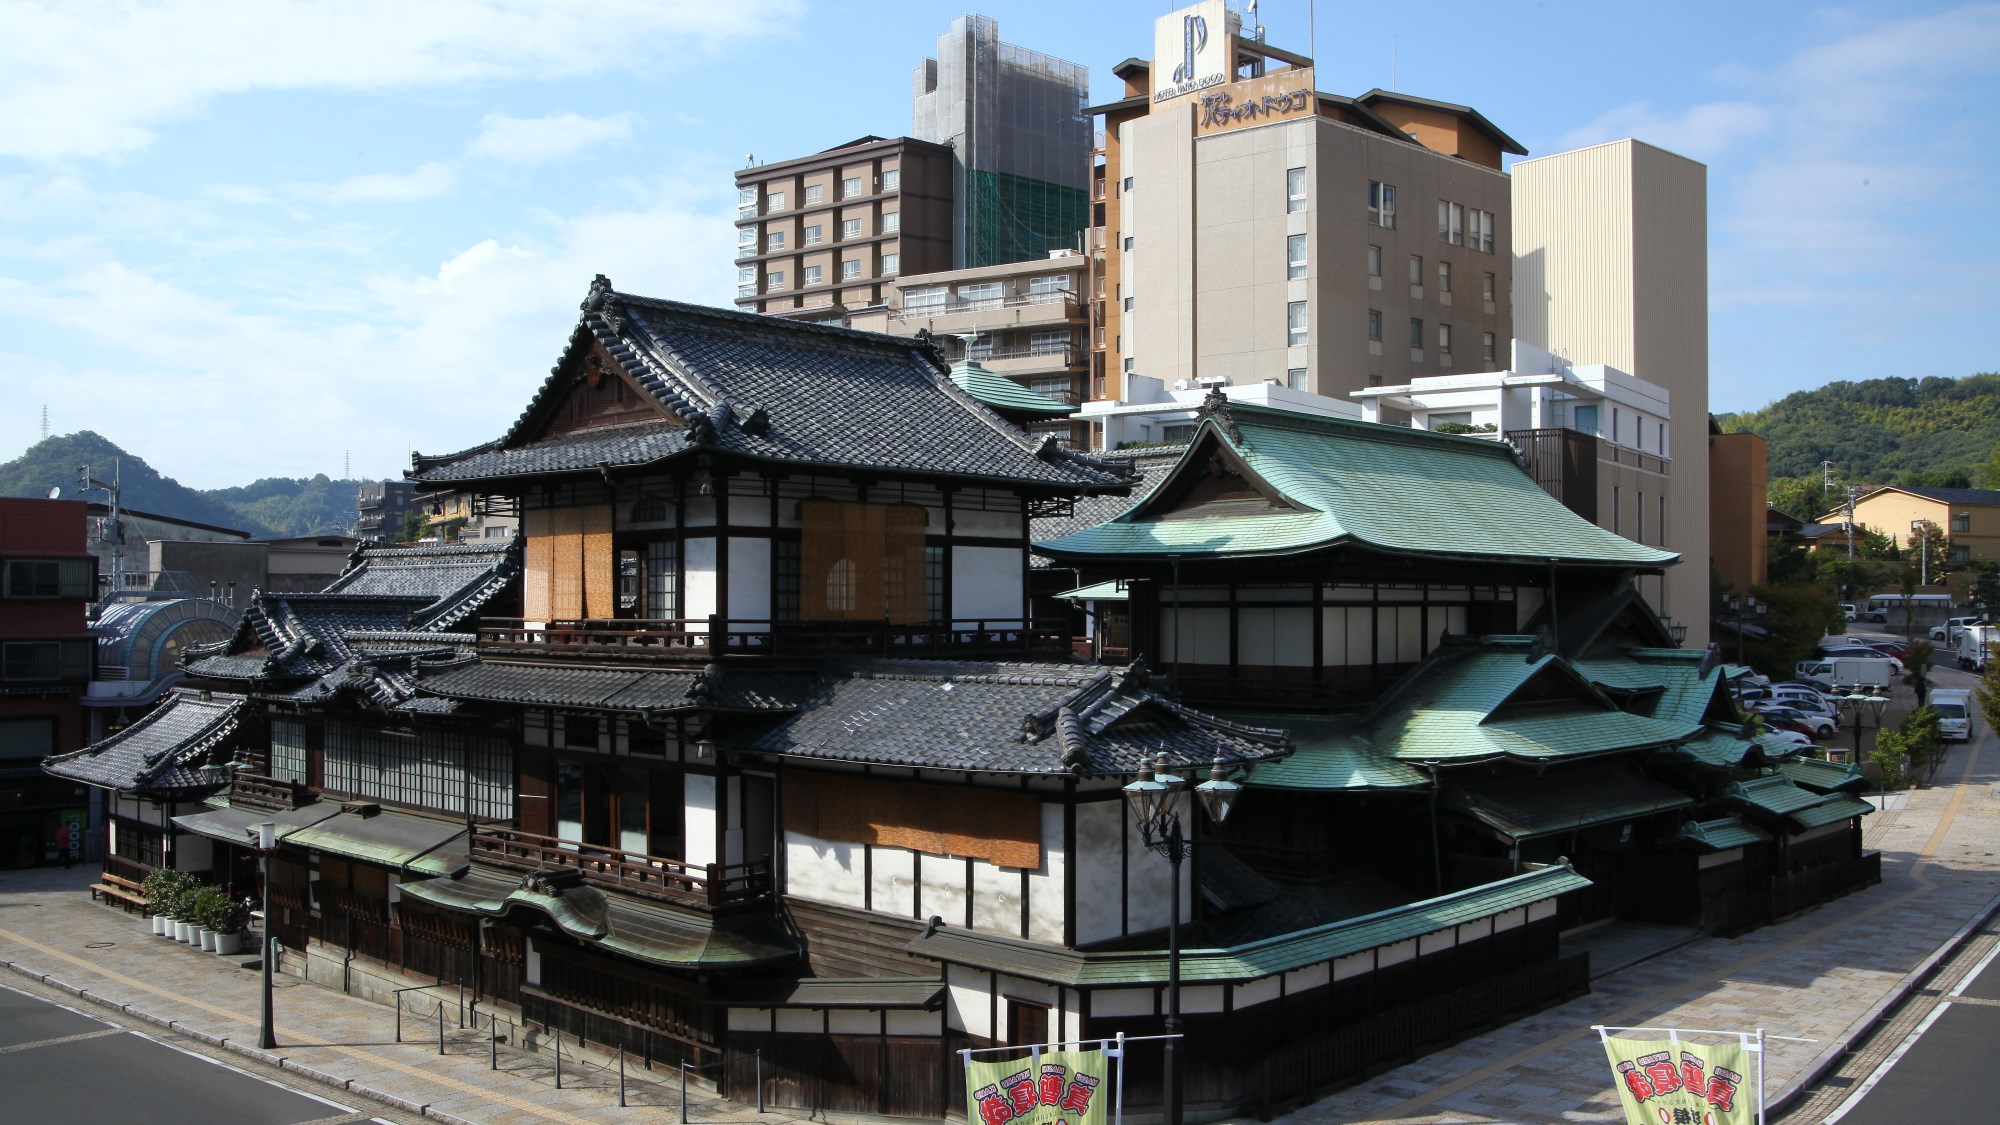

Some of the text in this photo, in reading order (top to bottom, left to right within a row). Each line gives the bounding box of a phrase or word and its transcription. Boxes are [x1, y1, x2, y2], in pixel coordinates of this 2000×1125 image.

[1155, 73, 1225, 101] HOTEL PATIO DOGO
[1201, 91, 1230, 106] ホテル
